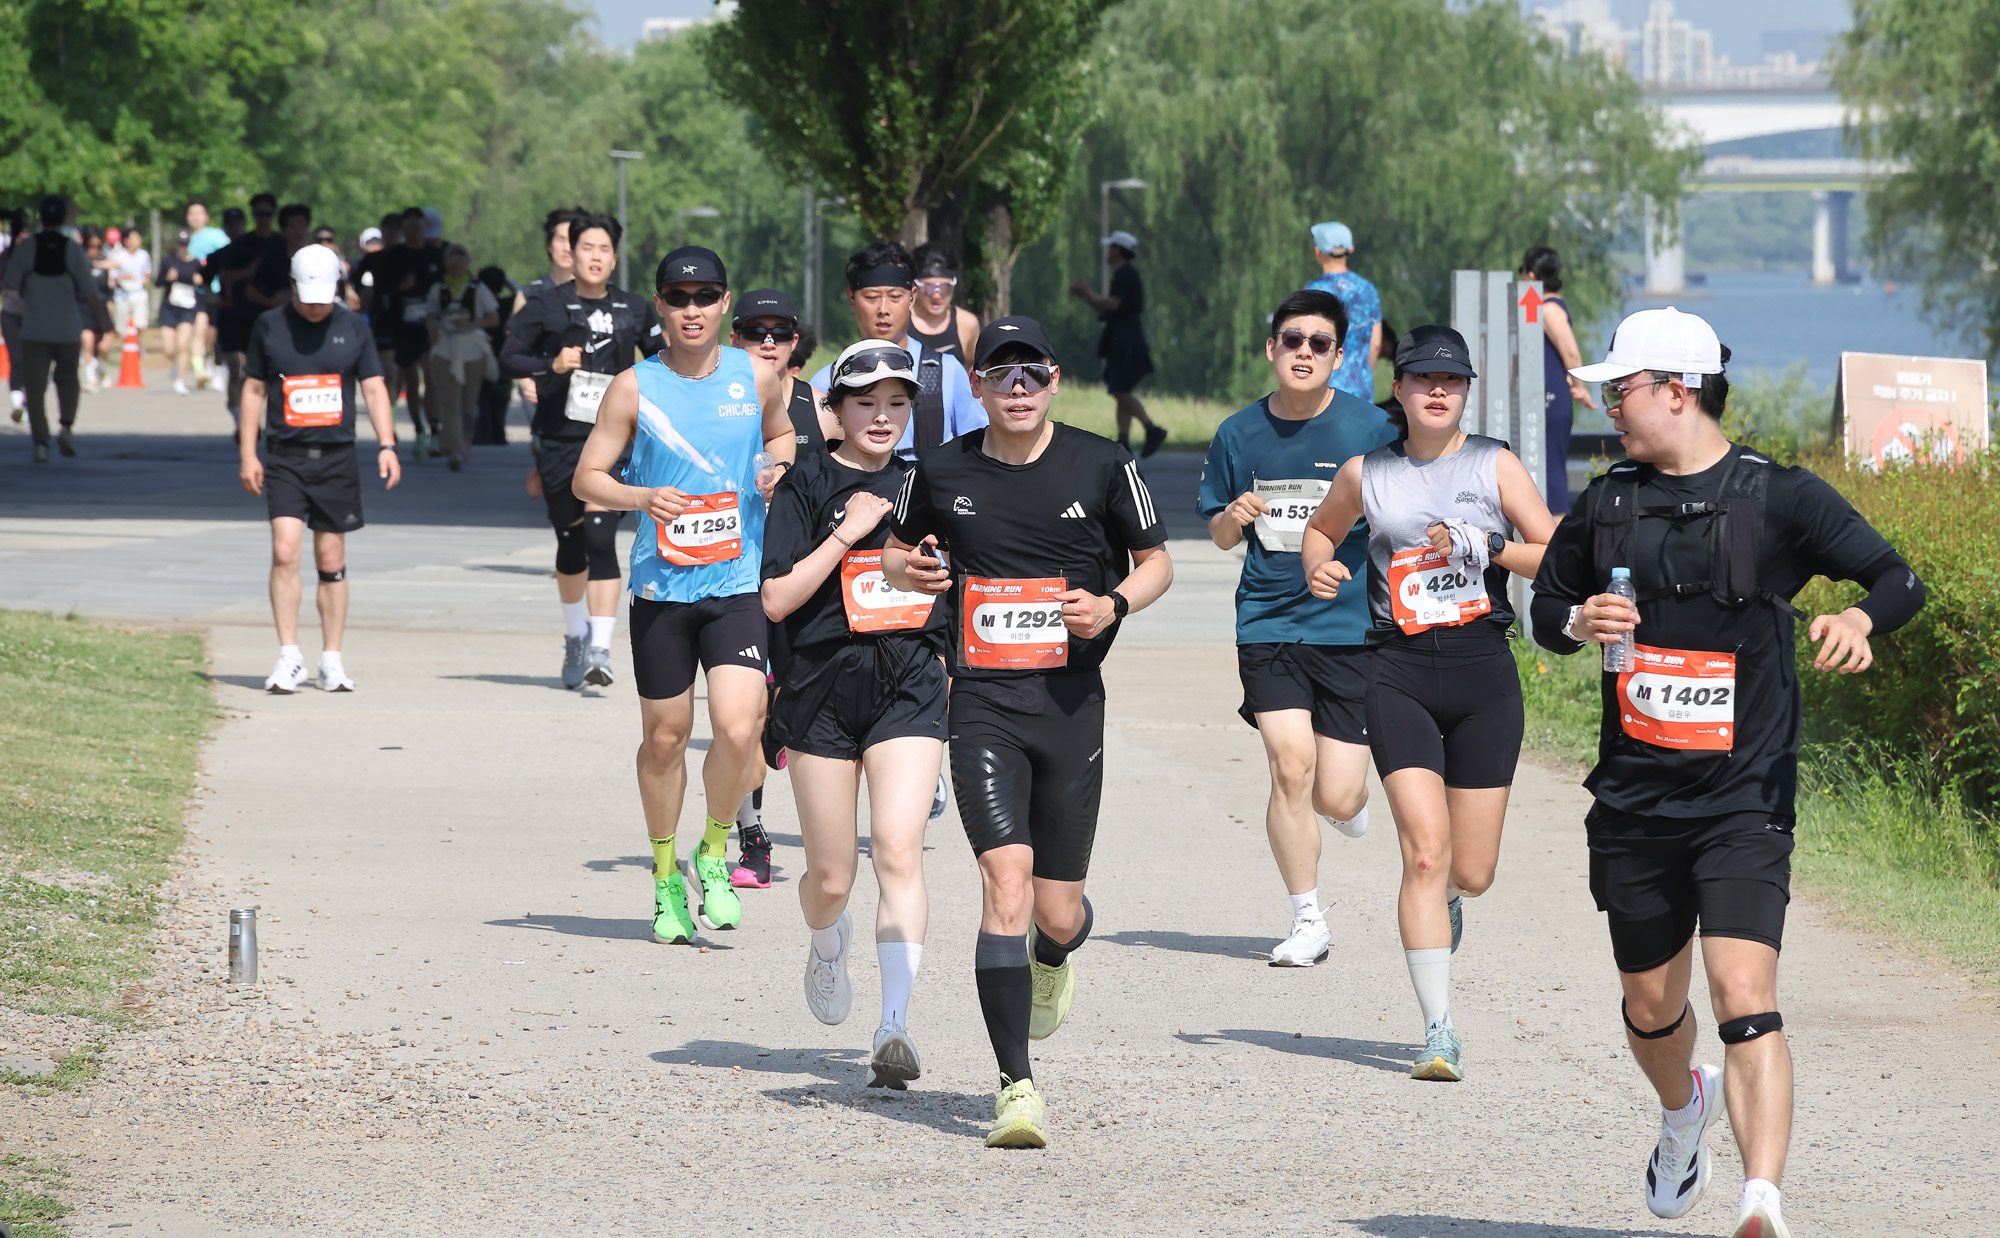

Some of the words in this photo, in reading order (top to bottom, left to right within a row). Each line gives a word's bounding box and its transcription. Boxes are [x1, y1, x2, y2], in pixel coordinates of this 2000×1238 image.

[718, 403, 757, 417] CHICAGO
[1257, 483, 1287, 492] BURNING
[1288, 483, 1303, 491] RUN
[1270, 508, 1283, 518] M
[673, 524, 685, 535] M
[691, 515, 737, 535] 1293
[1391, 554, 1423, 568] BURNING
[1424, 551, 1441, 561] RUN
[860, 580, 875, 594] W
[970, 583, 1002, 593] BURNING
[1003, 585, 1024, 593] RUN
[1407, 583, 1420, 597] W
[1426, 571, 1478, 593] 420
[981, 614, 996, 628] M
[1003, 609, 1063, 629] 1292
[1423, 610, 1446, 620] C-54
[1663, 655, 1686, 665] RUN
[1705, 660, 1729, 668] 10km
[1636, 684, 1652, 701] M
[1661, 684, 1730, 706] 1402
